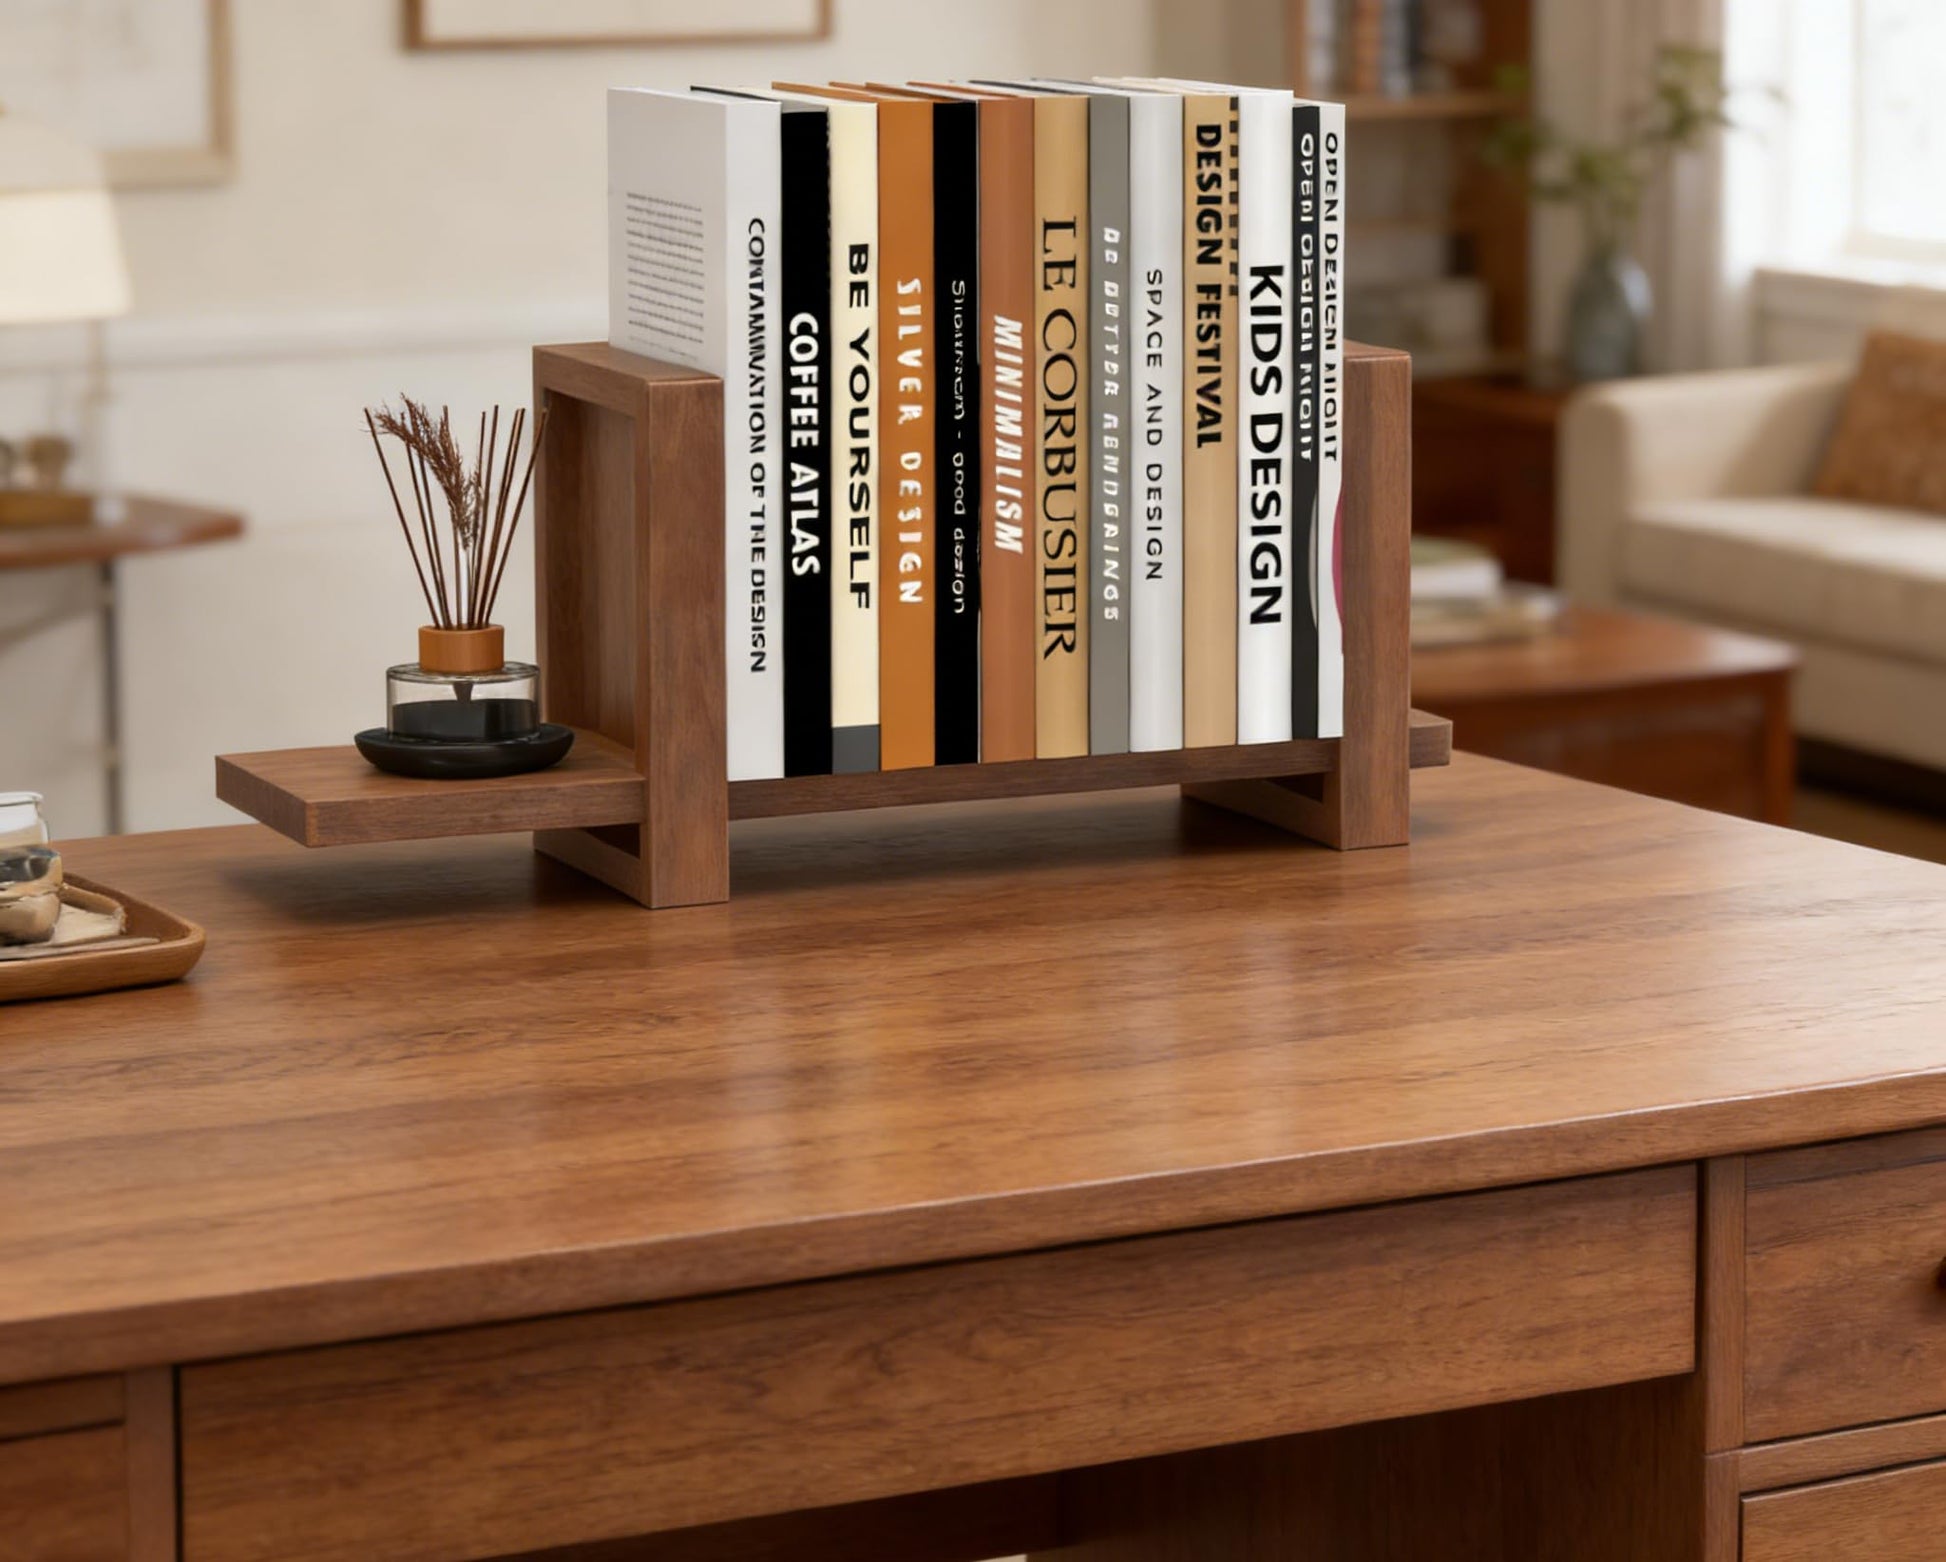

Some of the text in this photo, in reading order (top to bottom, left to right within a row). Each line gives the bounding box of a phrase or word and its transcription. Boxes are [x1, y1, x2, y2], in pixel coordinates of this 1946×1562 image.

[1196, 124, 1223, 448] DESIGN FESTIVAL
[1323, 132, 1339, 222] OPEN
[749, 462, 766, 498] OF
[749, 504, 766, 563] THE
[790, 313, 820, 575] COFFEE ATLAS
[849, 244, 870, 608] BE YOURSELF
[897, 278, 923, 602] SILVER DESIGN
[994, 316, 1023, 553] MINIMALISM
[1043, 216, 1077, 659] LE CORBUSIER
[1145, 268, 1164, 580] SPACE AND DESIGN
[1250, 265, 1284, 624] KIDS DESIGN
